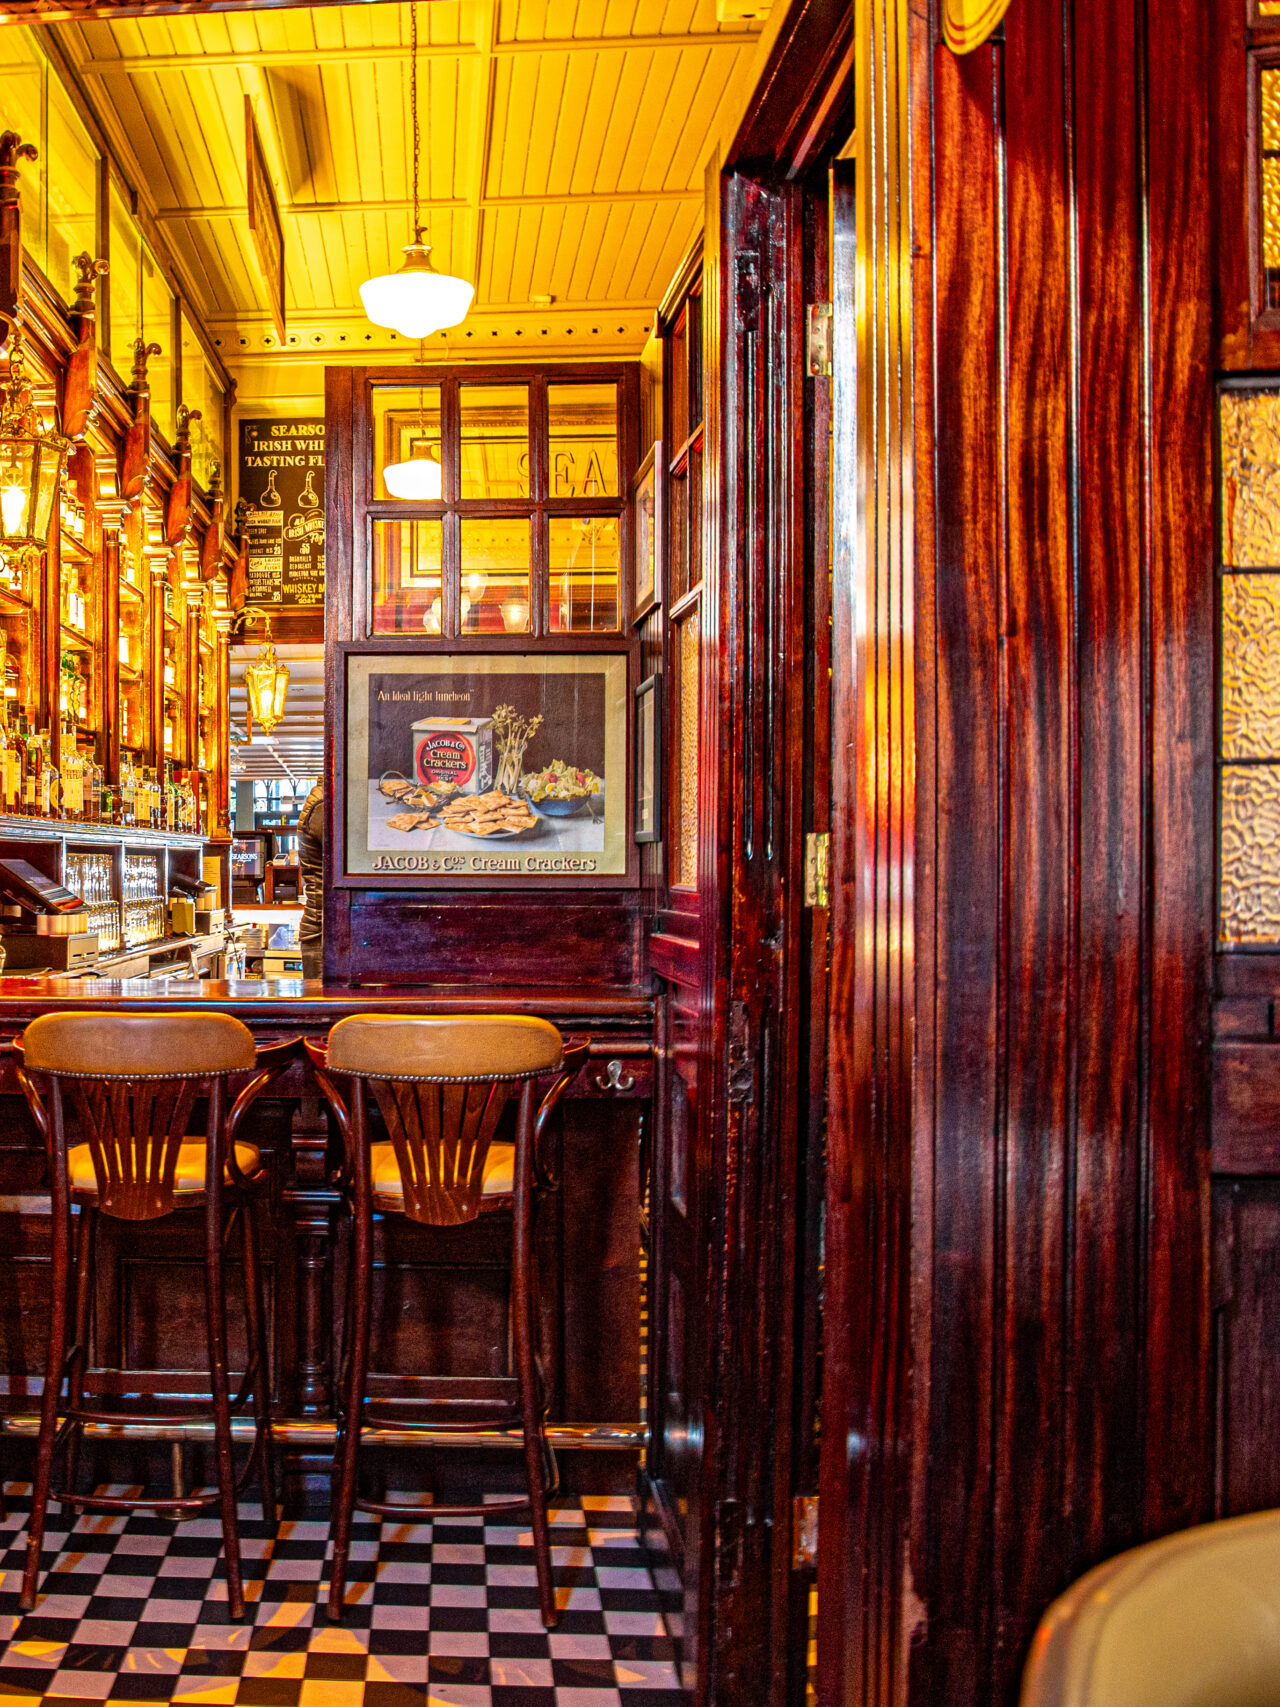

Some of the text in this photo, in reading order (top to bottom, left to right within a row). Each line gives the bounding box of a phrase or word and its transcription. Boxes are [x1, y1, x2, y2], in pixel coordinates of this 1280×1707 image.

[271, 424, 325, 436] SEARSO
[253, 440, 325, 451] IRISH WHI
[245, 455, 325, 467] TASTING FL
[305, 520, 325, 533] WHISKE
[282, 583, 317, 594] WHISKEY
[413, 690, 433, 703] light
[426, 740, 450, 751] JACOB
[430, 749, 461, 760] Cream
[423, 758, 467, 769] Crackers
[372, 855, 429, 871] JACOB
[431, 859, 440, 871] &
[470, 856, 521, 871] Cream
[525, 856, 598, 871] Crackers
